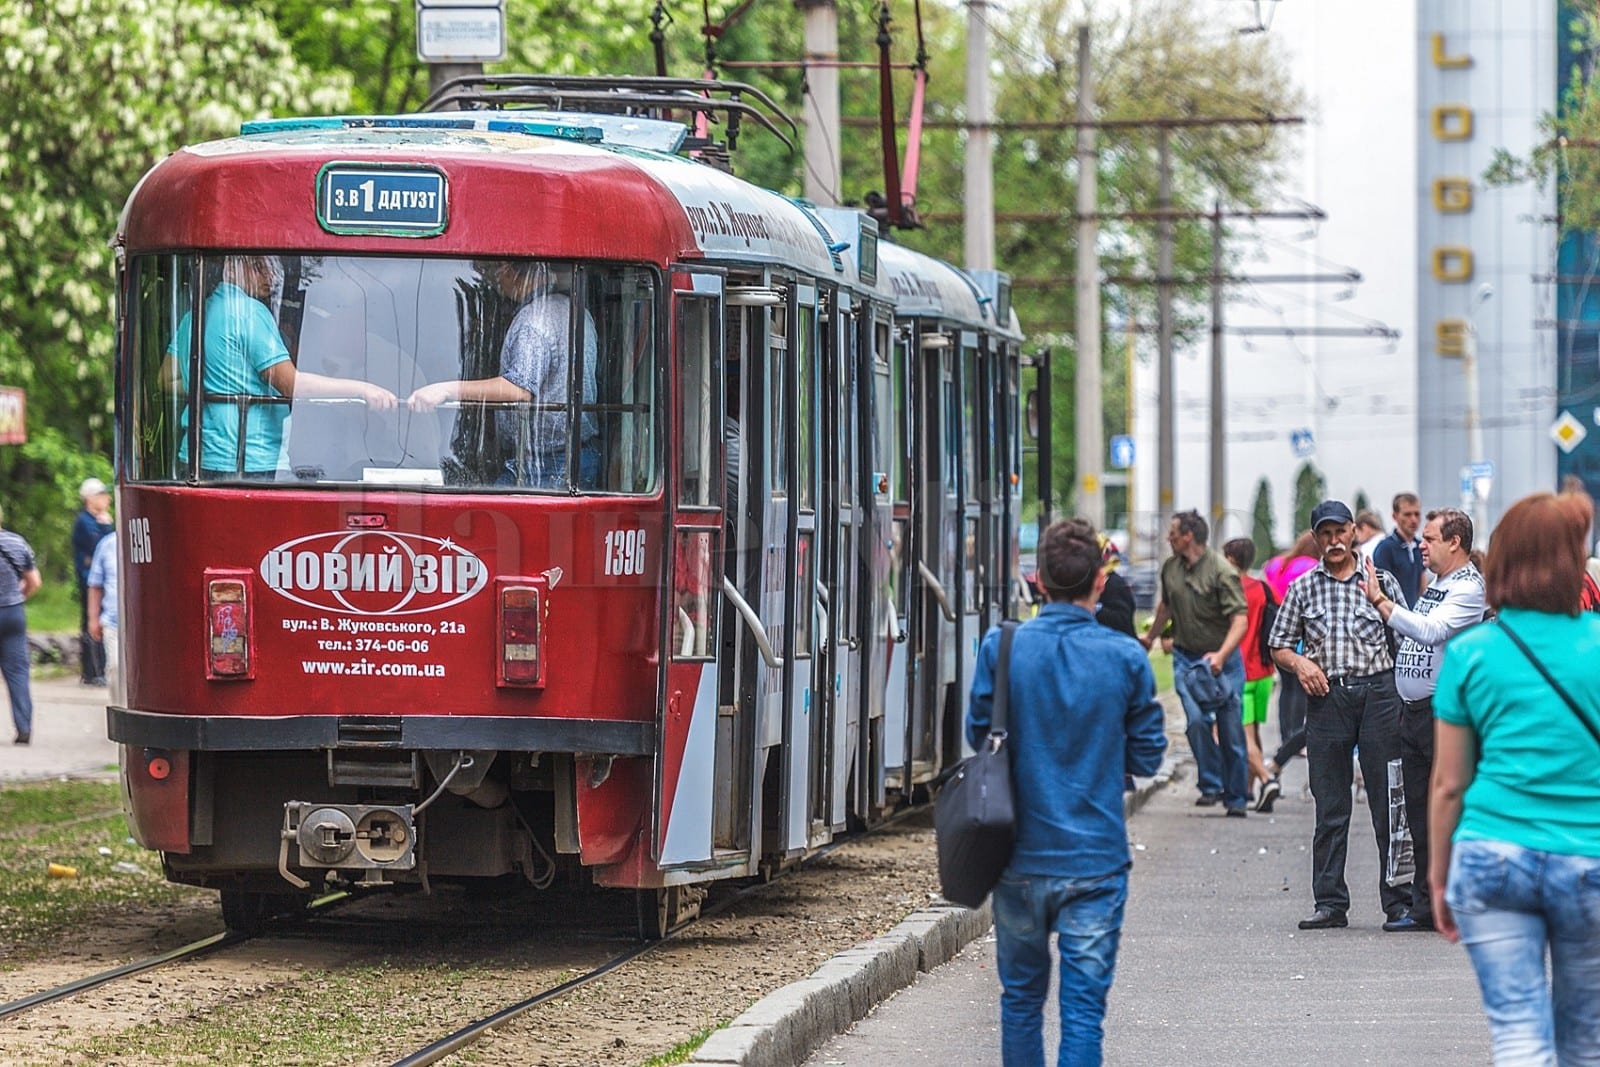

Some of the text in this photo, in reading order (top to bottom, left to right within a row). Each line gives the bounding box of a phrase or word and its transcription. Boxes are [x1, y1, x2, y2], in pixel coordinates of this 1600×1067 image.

[359, 180, 375, 212] 1
[1430, 32, 1474, 357] LOGOS
[128, 517, 153, 564] 1396
[604, 528, 646, 576] 1396
[268, 545, 480, 594] НОВИЙ ЗІР
[282, 617, 466, 636] вул.: В. Жуковського, 21а
[317, 638, 430, 653] тел.: 374-06-06
[301, 657, 446, 677] www.zir.com.ua
